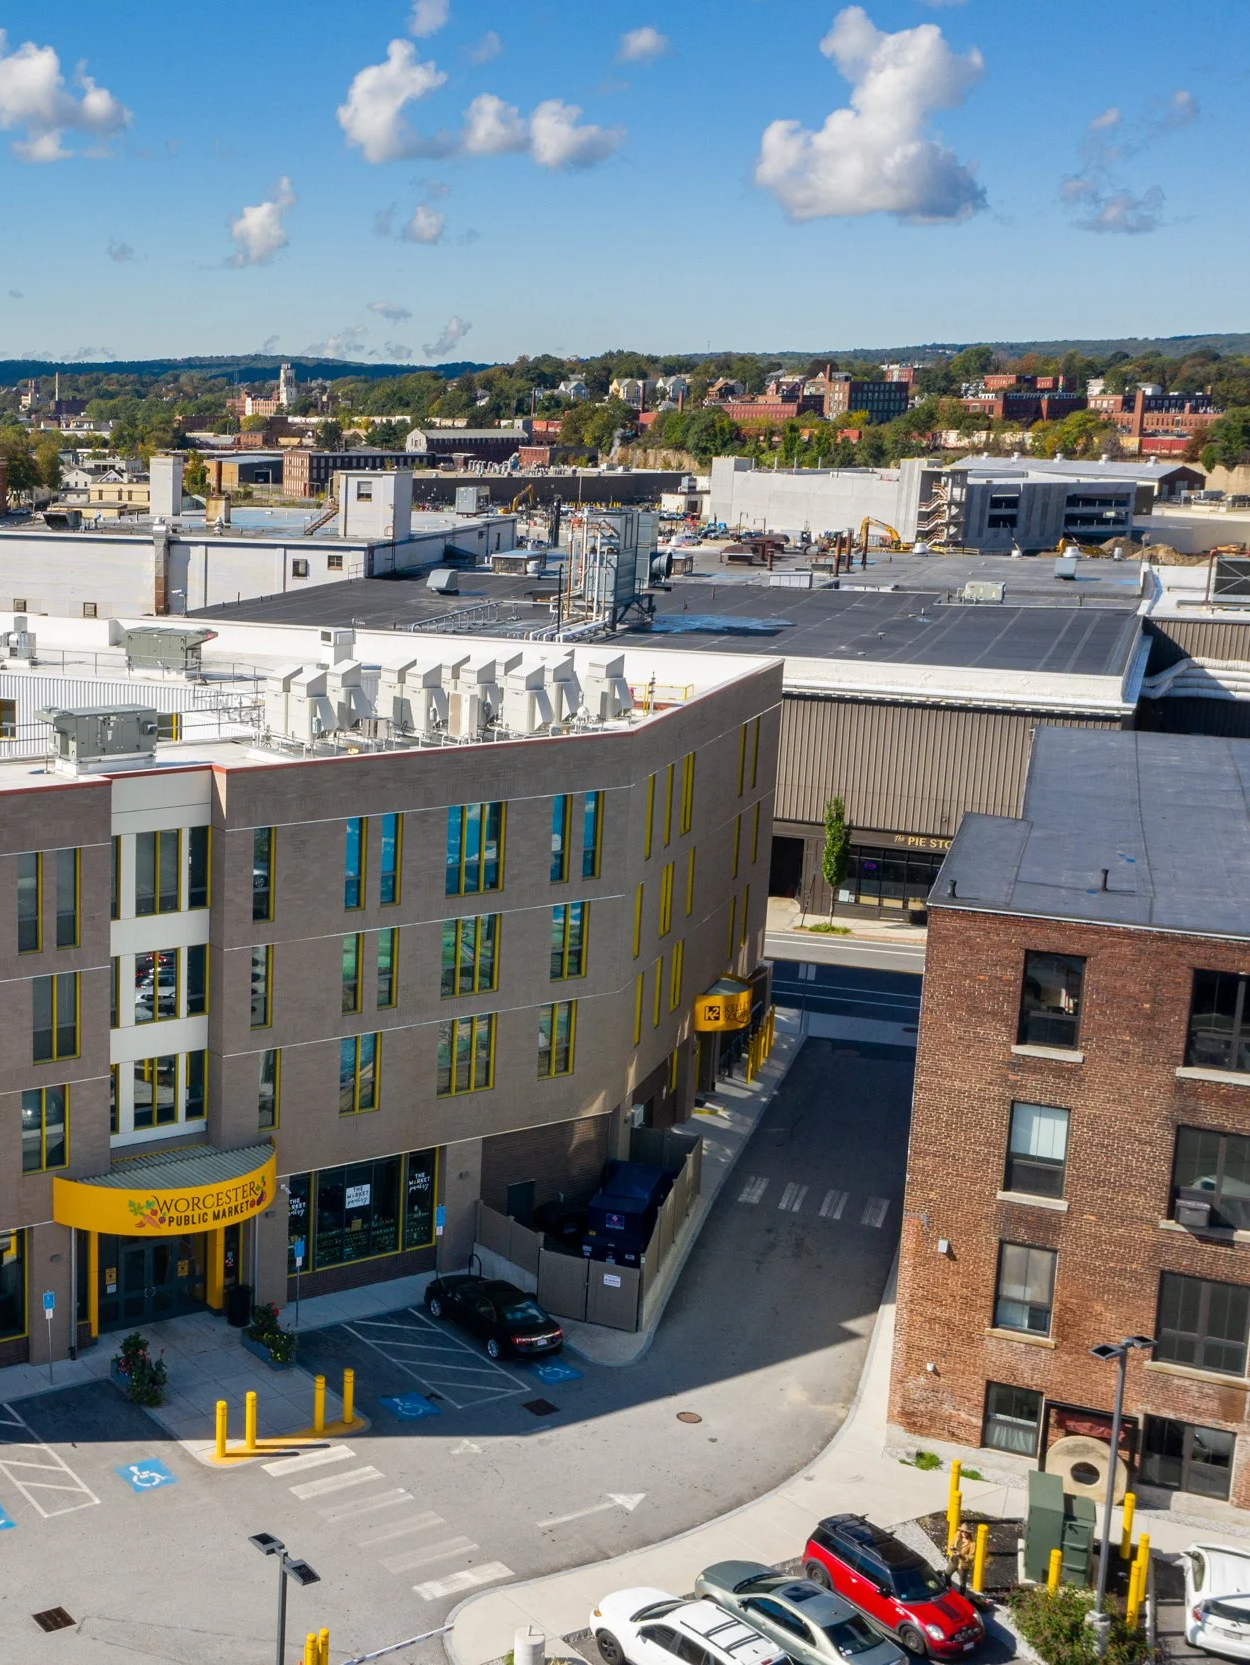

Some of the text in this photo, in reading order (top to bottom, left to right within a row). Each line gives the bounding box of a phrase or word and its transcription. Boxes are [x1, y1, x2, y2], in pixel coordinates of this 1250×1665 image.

[908, 836, 927, 847] PIE
[151, 1180, 259, 1213] WORCESTER
[168, 1200, 250, 1227] PUBLIC MARKET
